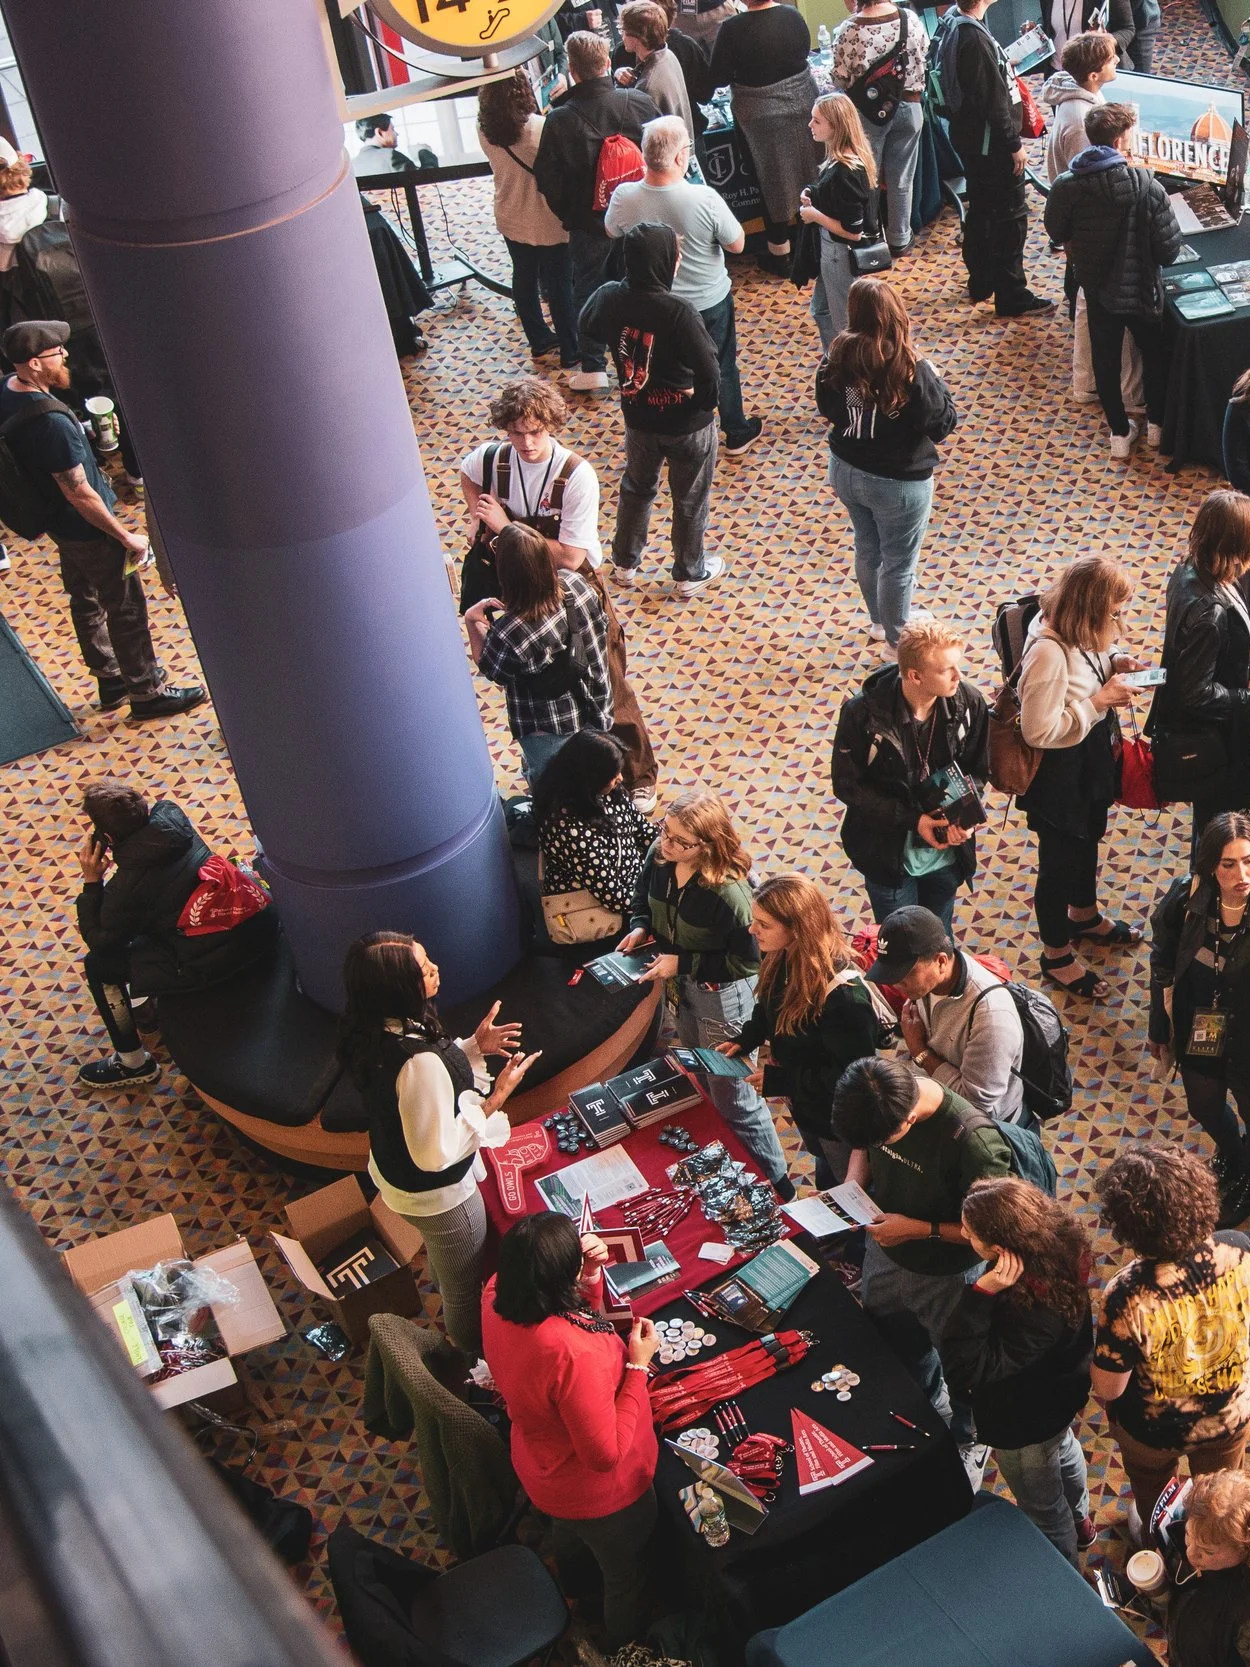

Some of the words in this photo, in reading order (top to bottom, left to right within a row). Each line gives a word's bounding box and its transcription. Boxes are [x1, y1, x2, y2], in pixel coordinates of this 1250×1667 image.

[1137, 132, 1230, 174] FLORENCE
[504, 1171, 516, 1190] OWLS
[507, 1190, 517, 1202] GO
